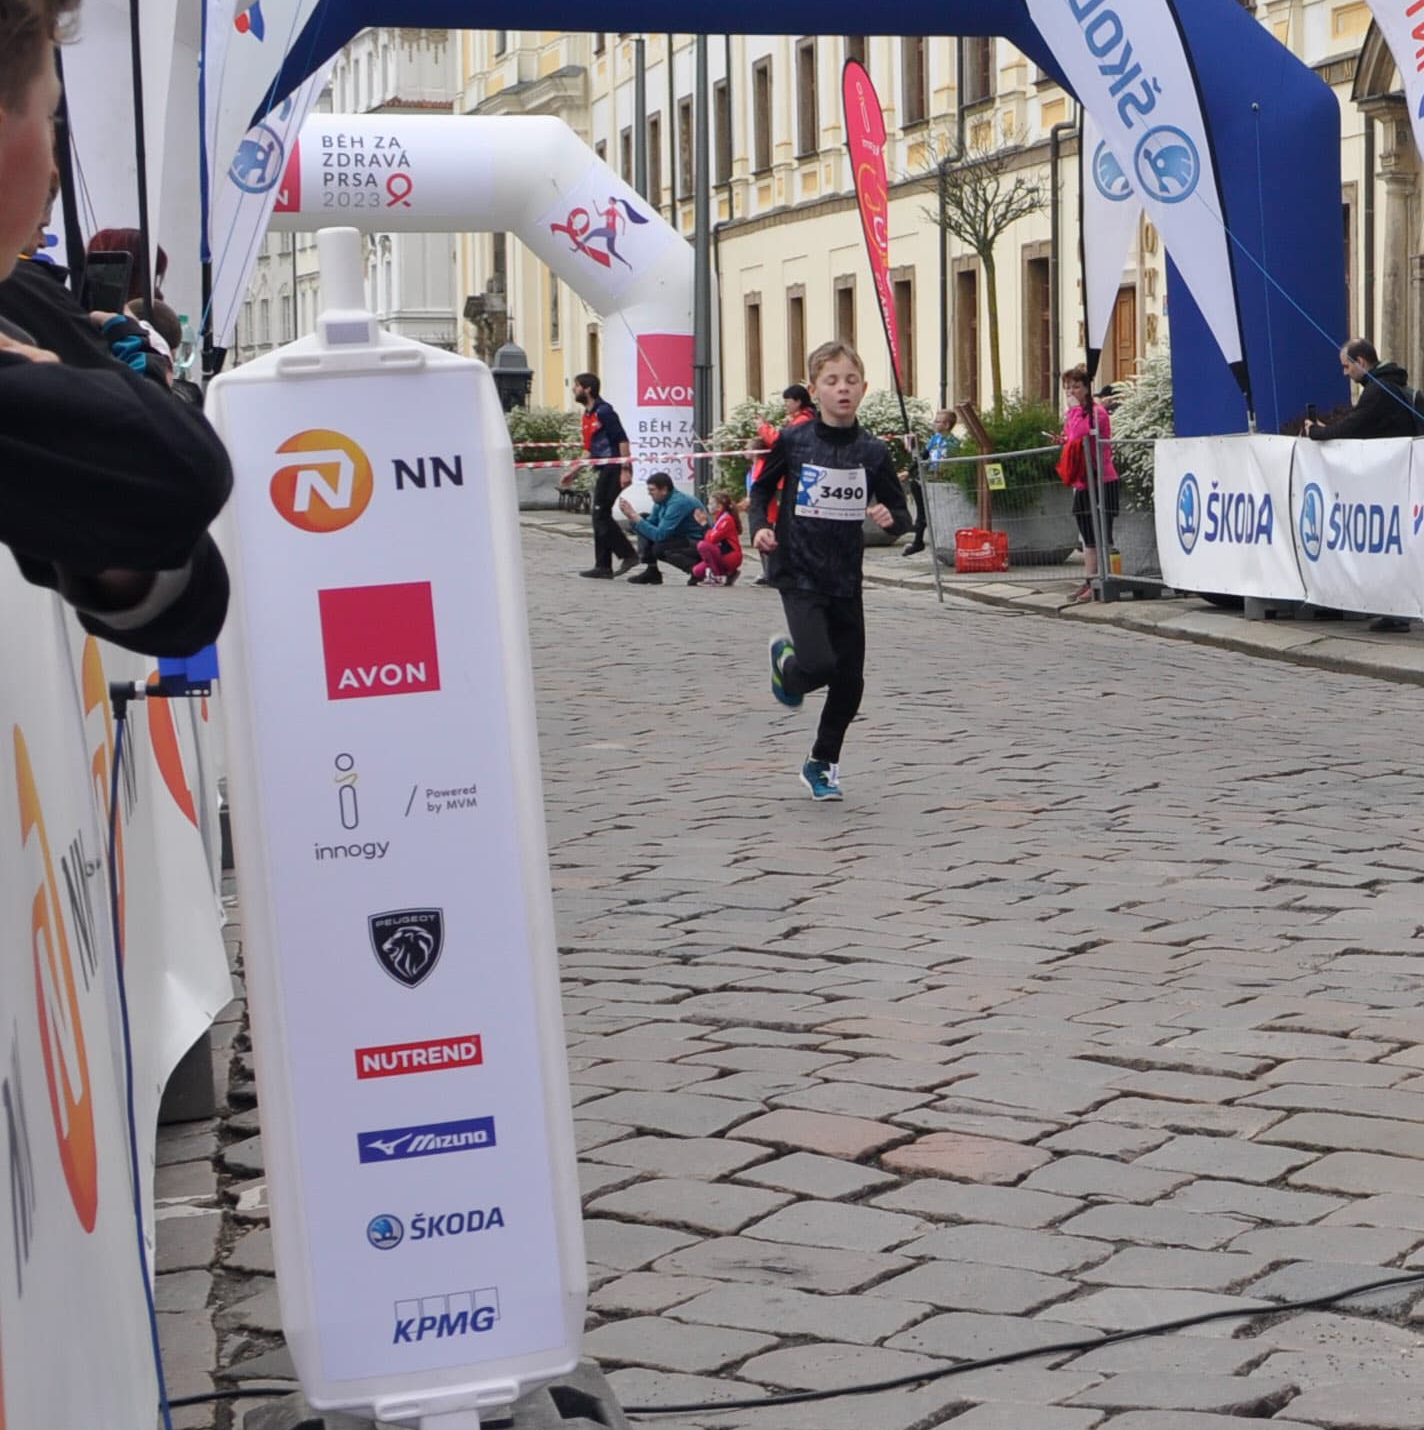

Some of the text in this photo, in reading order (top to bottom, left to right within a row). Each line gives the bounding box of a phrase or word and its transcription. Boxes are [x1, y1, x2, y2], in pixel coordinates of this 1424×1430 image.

[322, 134, 401, 149] BĚH ZA
[322, 150, 411, 168] ZDRAVÁ
[323, 172, 378, 187] PRSA
[323, 191, 380, 207] 2023
[393, 455, 464, 490] NN
[820, 485, 864, 500] 3490
[1204, 480, 1273, 545] ŠKODA
[1327, 492, 1403, 556] ŠKODA
[338, 662, 427, 690] AVON
[426, 783, 477, 799] Powered
[427, 798, 478, 814] by MVM
[314, 840, 390, 861] innogy
[375, 914, 436, 927] PEUGEOT
[362, 1041, 477, 1073] NUTREND
[409, 1205, 505, 1242] ŠKODA
[393, 1306, 496, 1345] KPMG
